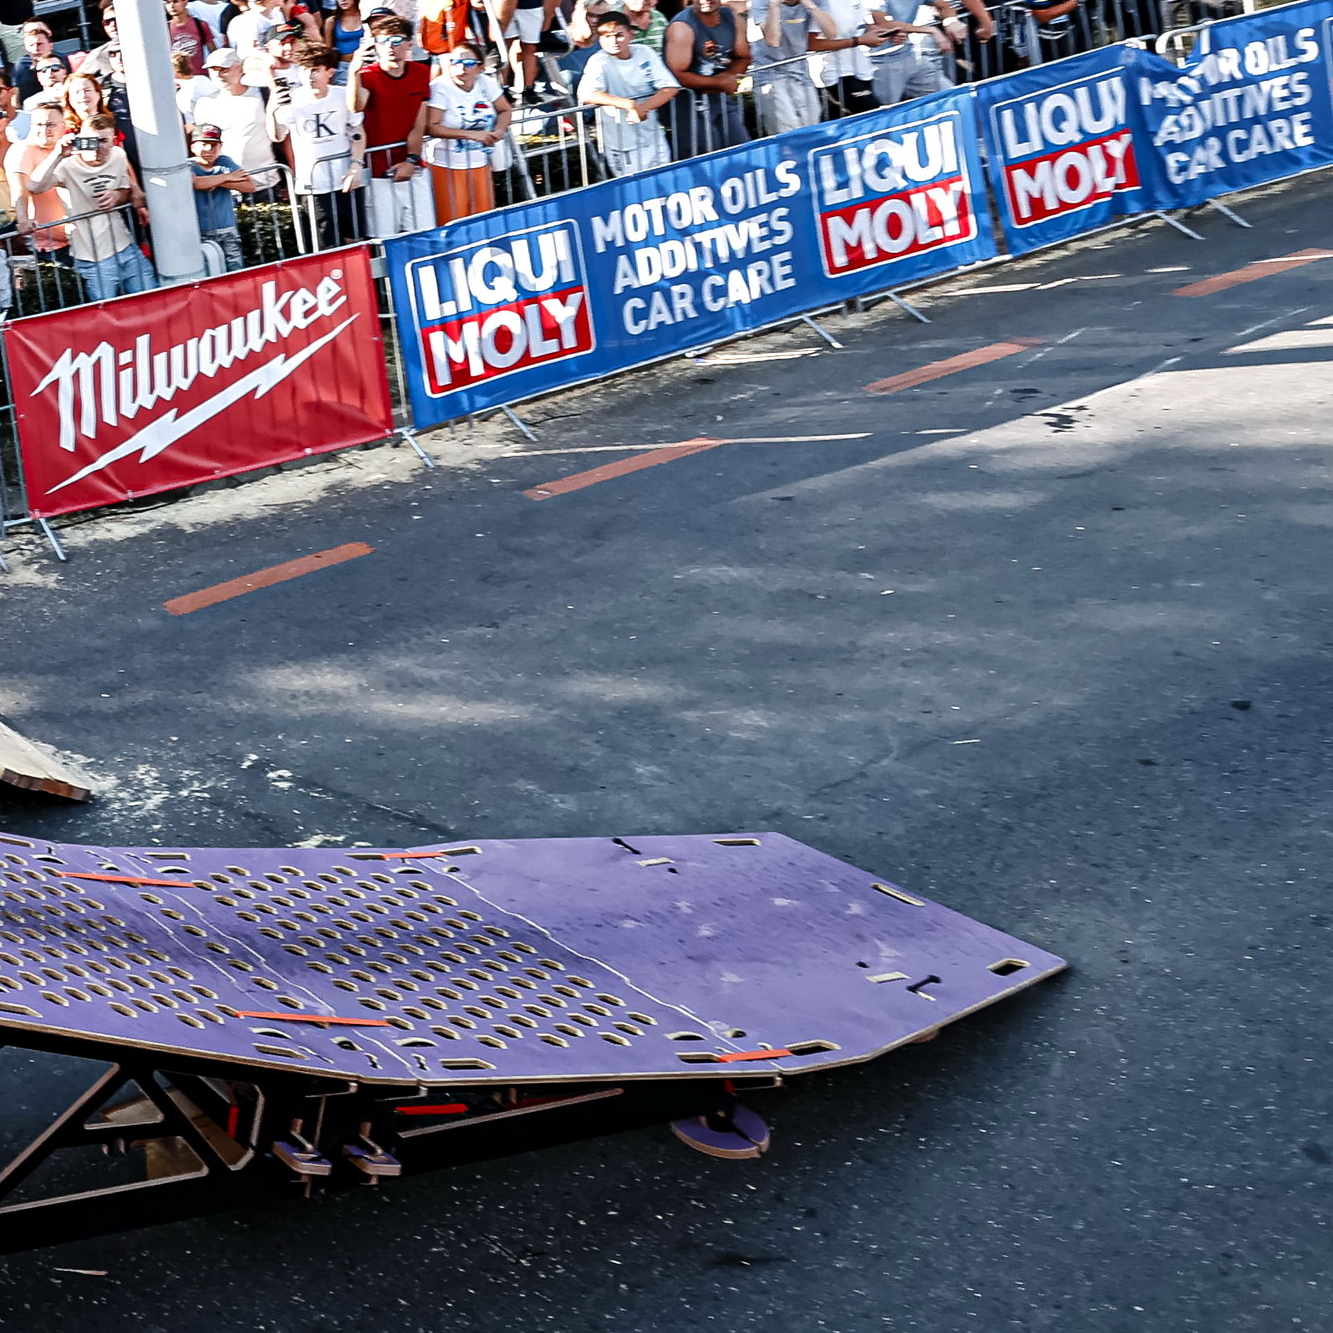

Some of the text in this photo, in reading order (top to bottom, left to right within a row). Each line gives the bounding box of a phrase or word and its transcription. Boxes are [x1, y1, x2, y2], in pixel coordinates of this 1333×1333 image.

[1245, 28, 1319, 76] OILS
[1001, 76, 1128, 159] LIQUI
[1165, 111, 1316, 184] CAR CARE
[818, 120, 959, 206] LIQUI
[1012, 133, 1133, 219] MOLY
[592, 159, 802, 254] MOTOR OILS
[825, 180, 964, 267] MOLY
[417, 229, 573, 322] LIQUI
[614, 207, 794, 295] ADDITIVES
[622, 251, 796, 336] CAR CARE
[29, 270, 347, 452] Milwaukee
[429, 290, 584, 386] MOLY
